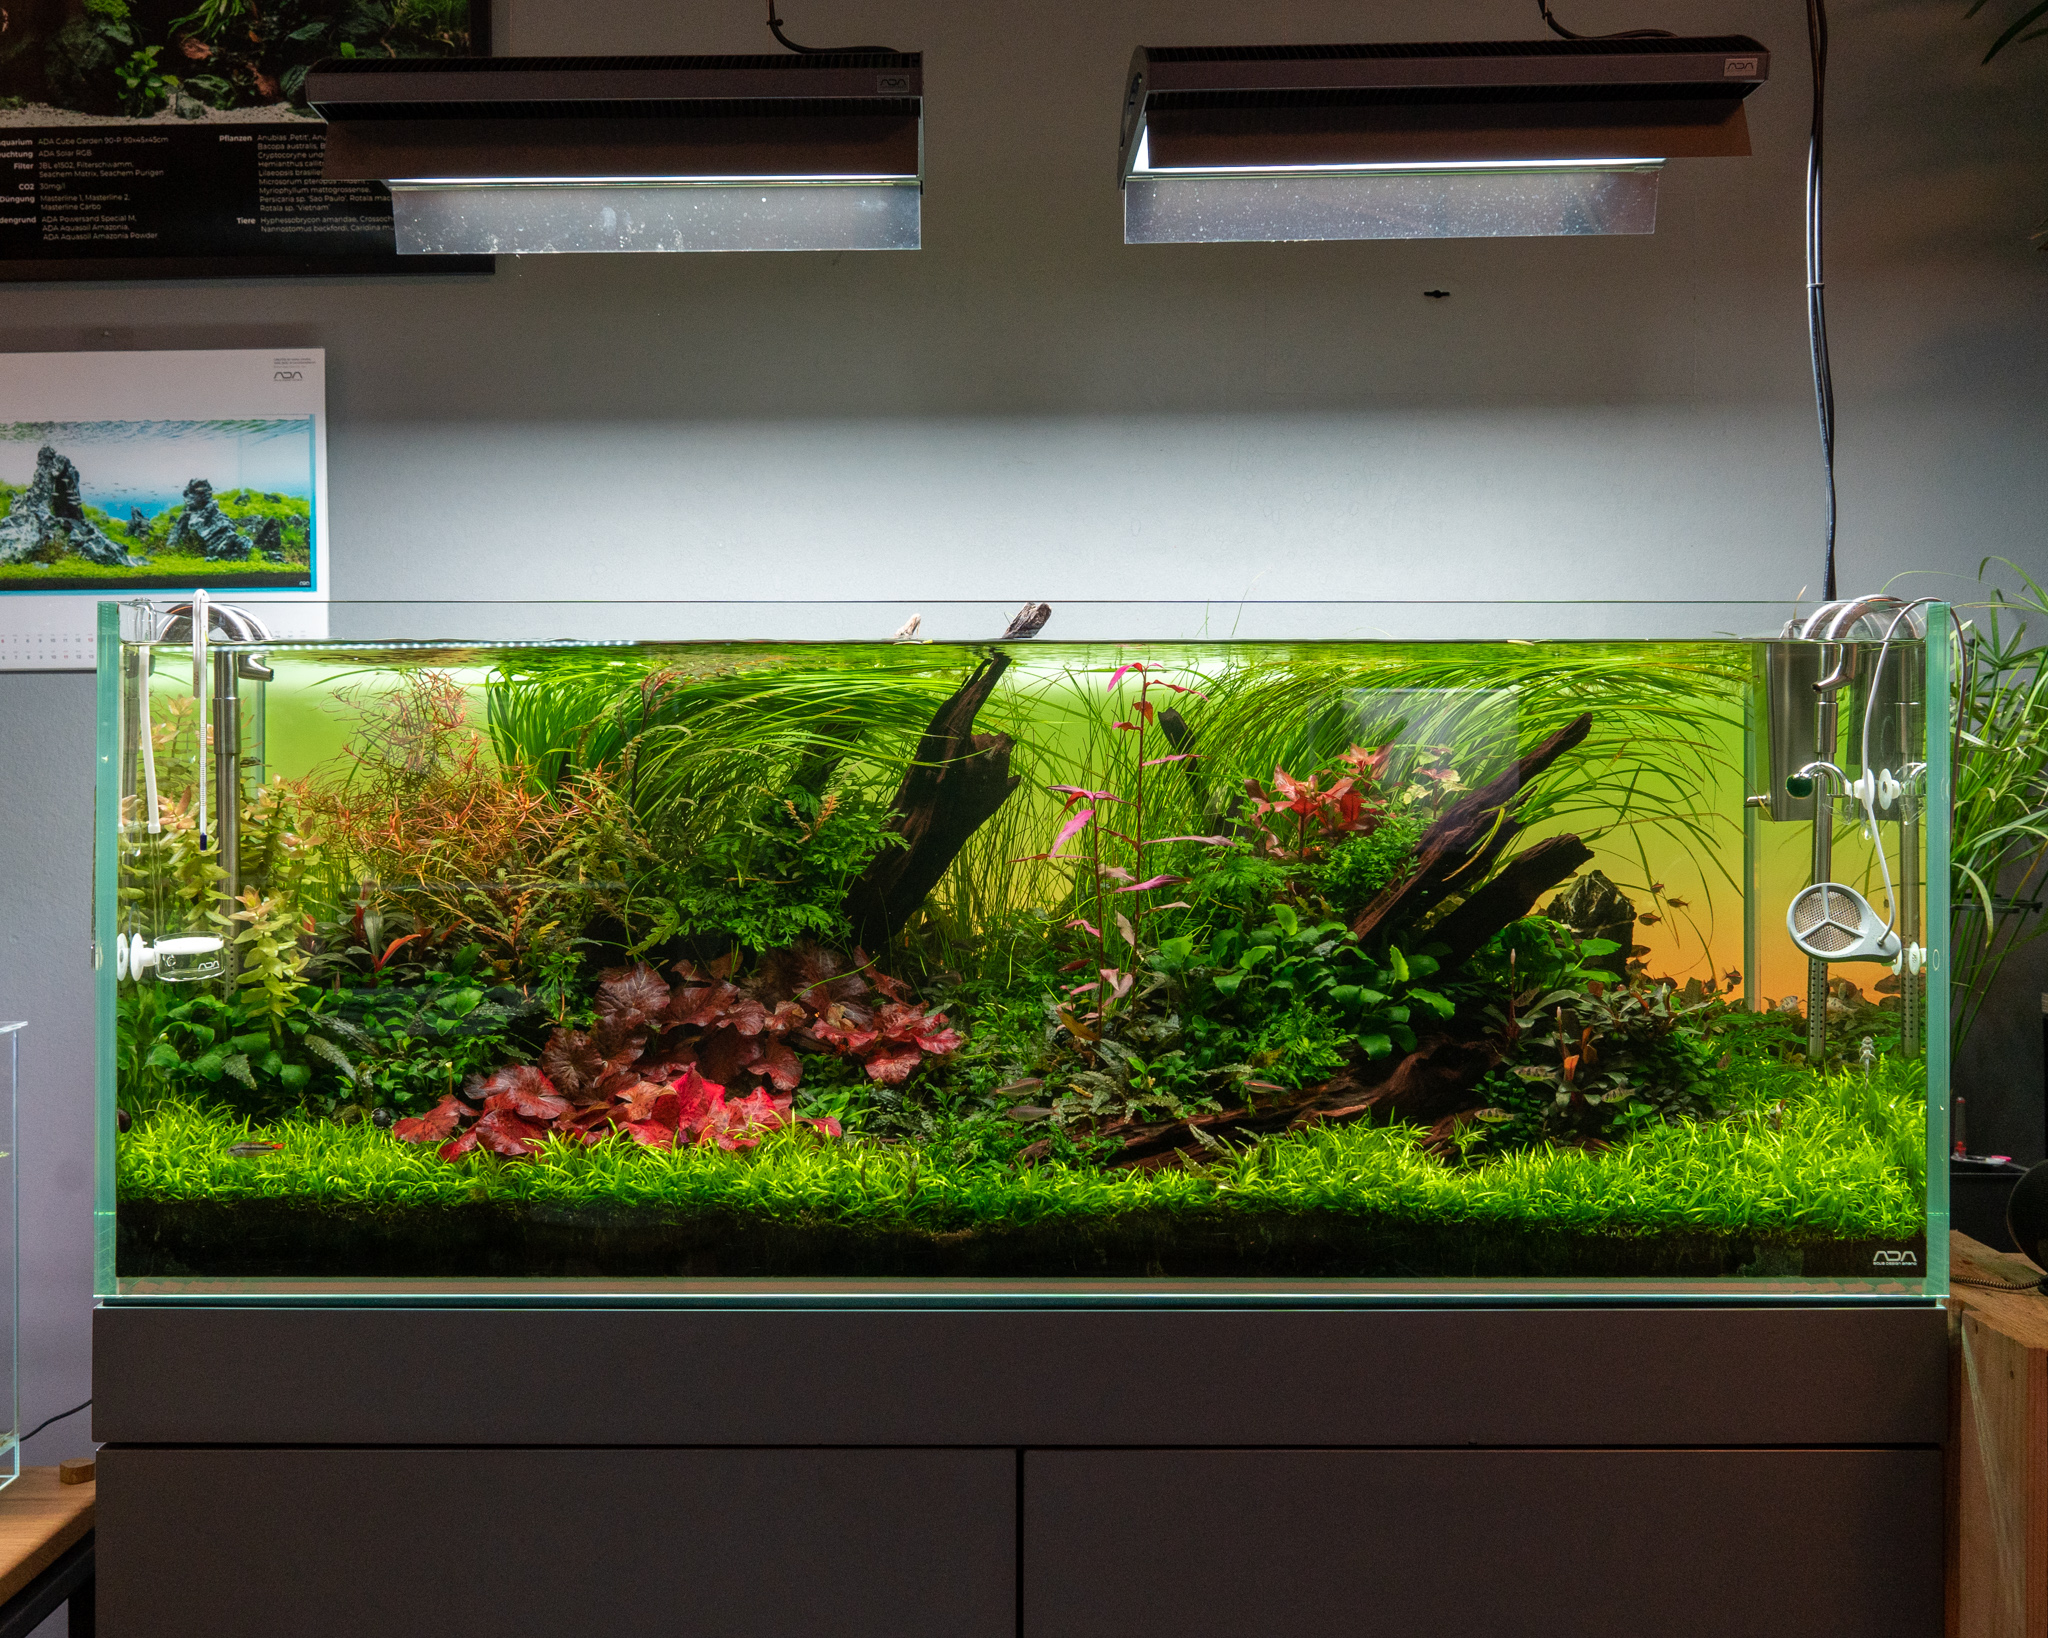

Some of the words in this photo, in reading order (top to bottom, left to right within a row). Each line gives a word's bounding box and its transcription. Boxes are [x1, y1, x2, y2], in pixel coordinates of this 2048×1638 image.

[0, 138, 33, 147] quarium
[360, 215, 395, 223] Crossoch
[1873, 1251, 1917, 1262] ADA
